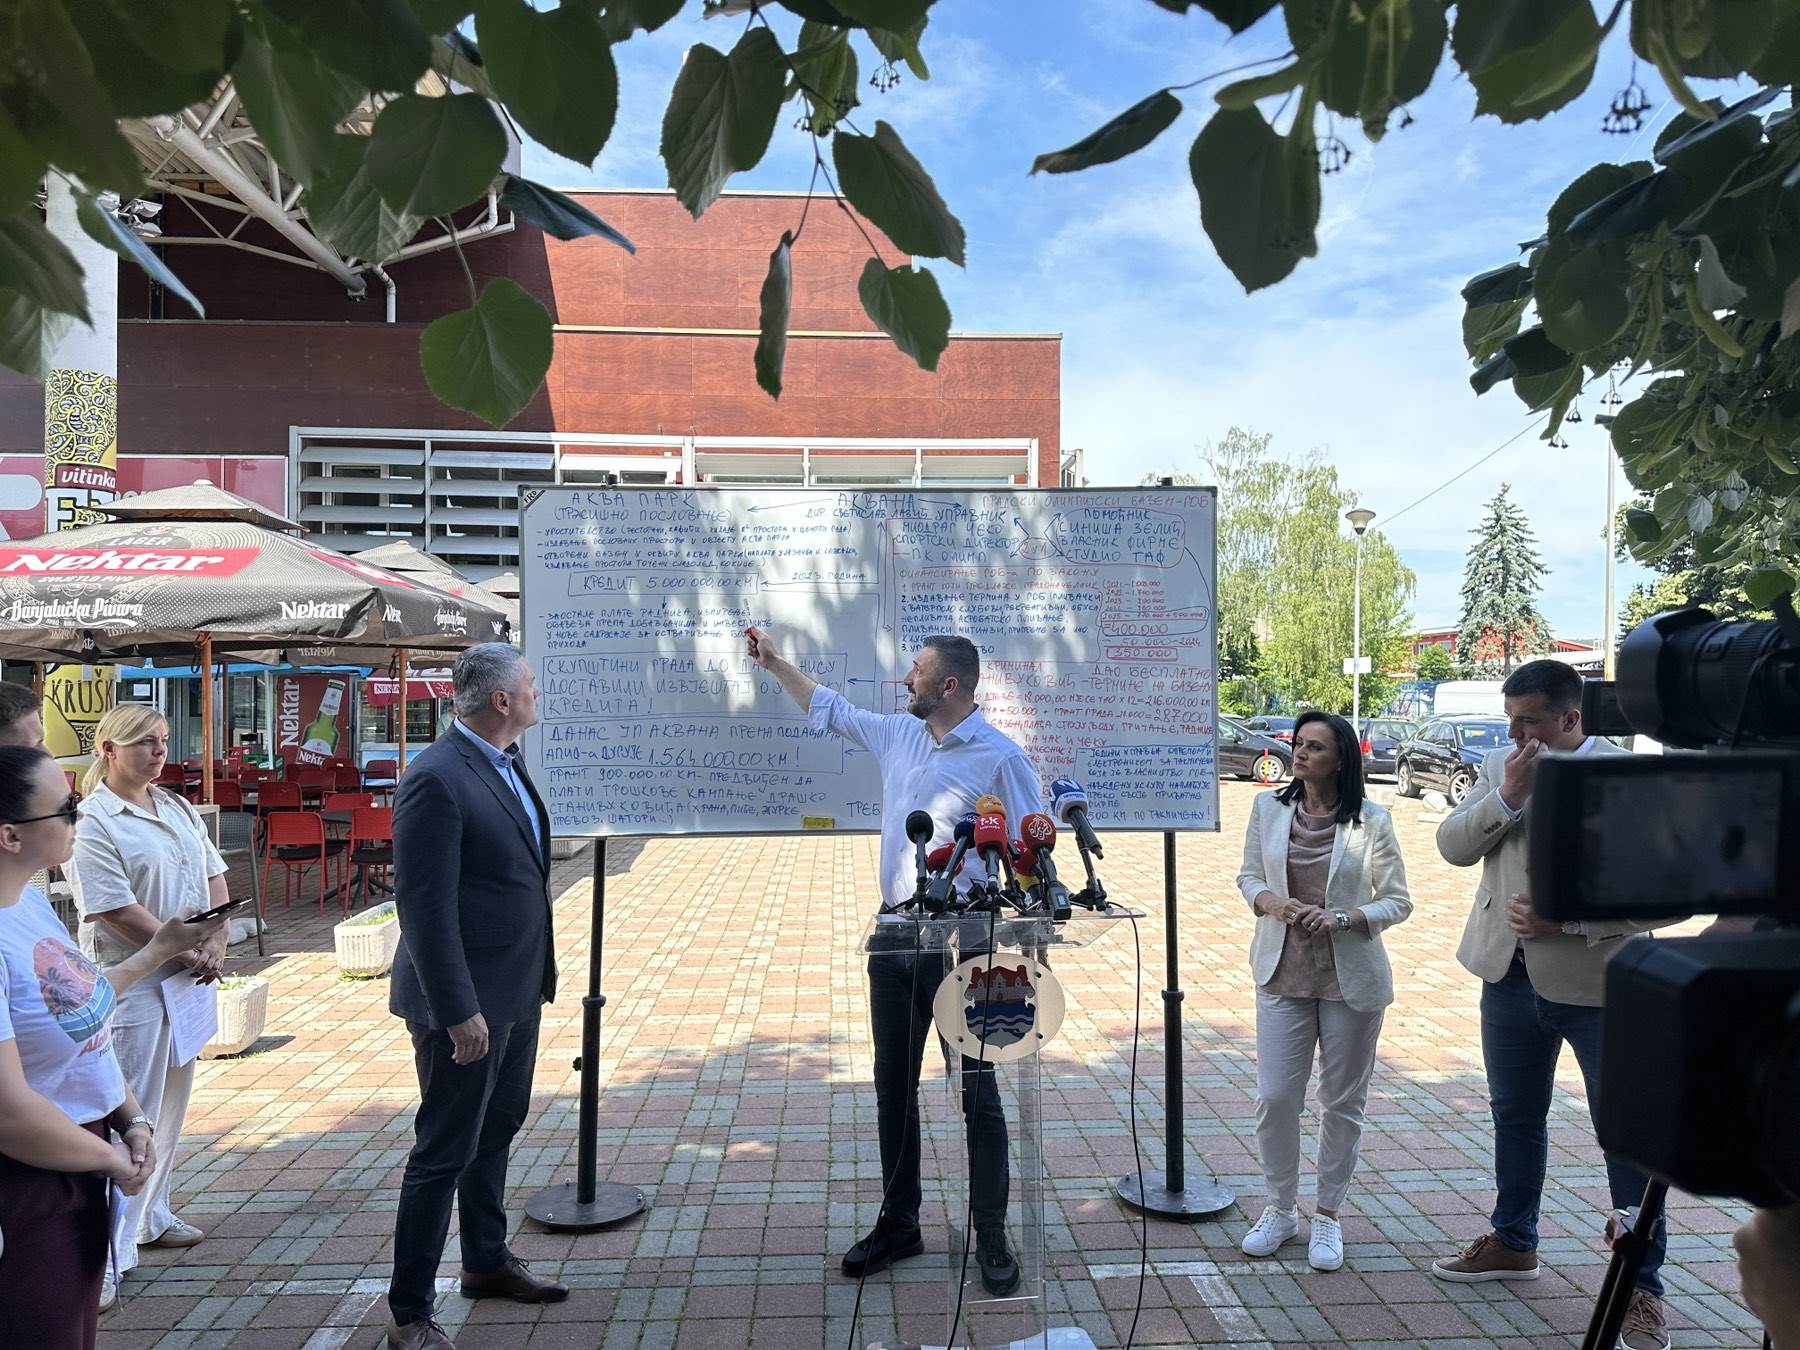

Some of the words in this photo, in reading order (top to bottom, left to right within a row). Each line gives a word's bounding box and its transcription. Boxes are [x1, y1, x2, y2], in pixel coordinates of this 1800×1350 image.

[571, 492, 625, 507] АКВА
[639, 491, 695, 509] ПАРК
[837, 492, 916, 511] АКВАНА
[1084, 508, 1151, 520] ПОМОЋНИК
[902, 521, 957, 535] МИОДРАГ
[1059, 521, 1123, 536] СИНИША
[1132, 522, 1183, 536] ЗЕЛИЋ
[106, 537, 173, 547] LAGER
[895, 534, 955, 549] СПОРТСКИ
[1127, 535, 1179, 552] ФИРМЕ
[1, 550, 225, 572] Nektar
[941, 548, 987, 563] ОЛИМП
[1065, 549, 1122, 562] СТУДИО
[583, 574, 637, 592] КРЕДИТ
[911, 593, 969, 603] ИЗДАВАЊЕ
[968, 591, 1010, 602] ТЕРМИНА
[91, 597, 144, 620] Pivara
[279, 600, 351, 620] Nektar
[547, 657, 640, 675] СКУПШТИНИ
[652, 657, 695, 674] ГРАДА
[703, 657, 729, 673] ДО
[799, 659, 836, 675] НИСУ
[1091, 664, 1121, 677] ДАО
[1128, 665, 1211, 680] БЕСПЛАТНО
[51, 668, 113, 714] KRUŠK
[545, 678, 646, 697] ДОСТАВИЛИ
[280, 679, 300, 749] Nektar
[549, 725, 609, 741] ДАНАС
[650, 724, 719, 739] АКВАНА
[549, 767, 591, 783] ГРАНТ
[549, 785, 594, 799] ПЛАТИ
[602, 784, 679, 798] ТРОШКОВЕ
[766, 791, 828, 804] ДРАШКО
[846, 800, 882, 817] ТРЕБ
